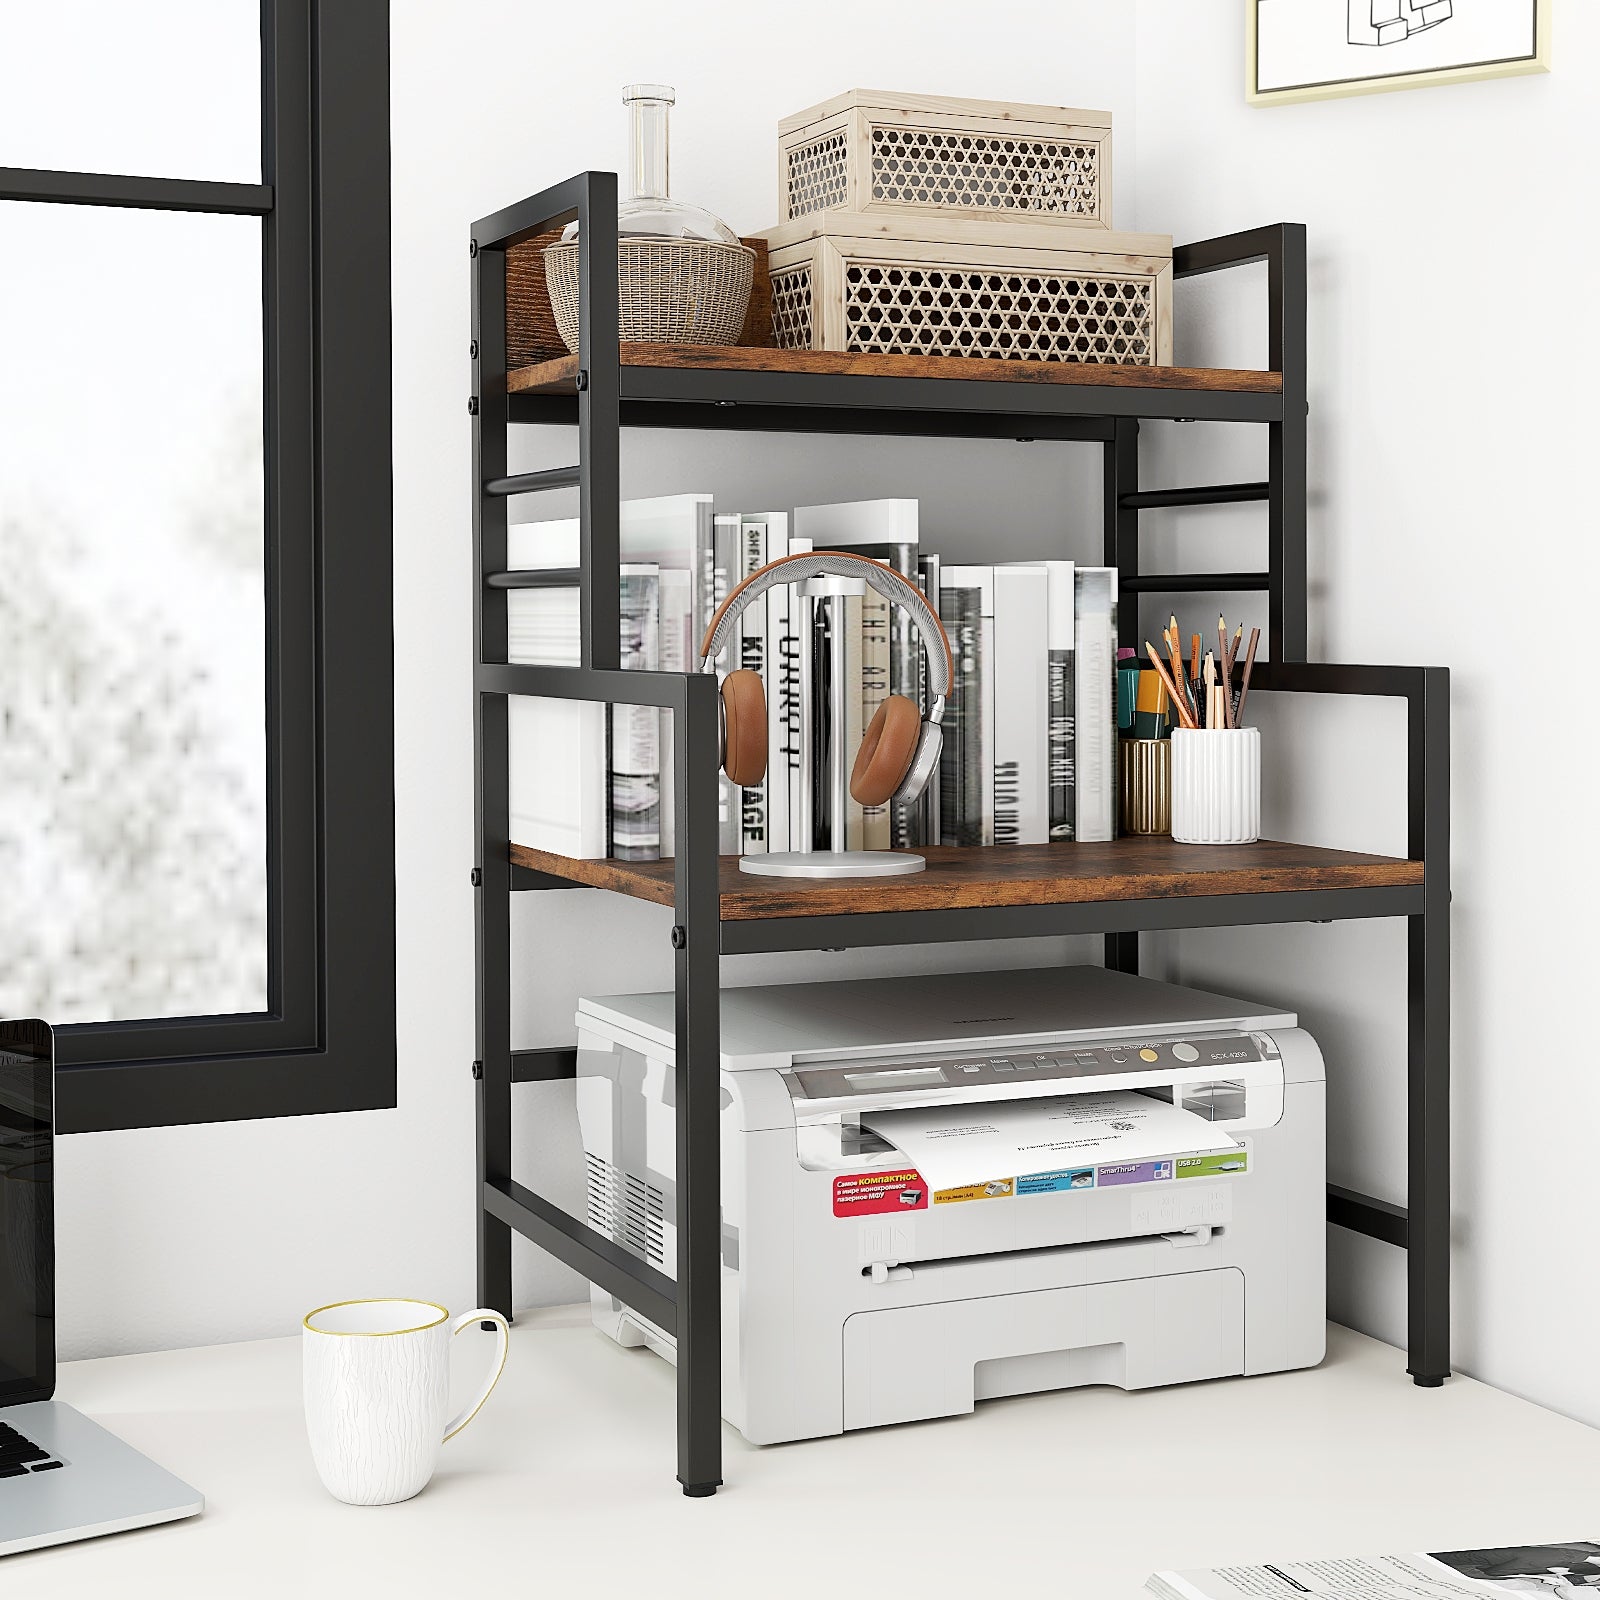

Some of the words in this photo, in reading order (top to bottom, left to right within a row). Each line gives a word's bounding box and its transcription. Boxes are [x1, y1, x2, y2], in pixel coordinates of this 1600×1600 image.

[862, 603, 886, 643] THE
[1191, 1158, 1202, 1166] 2.0
[868, 1191, 885, 1200] МФУ
